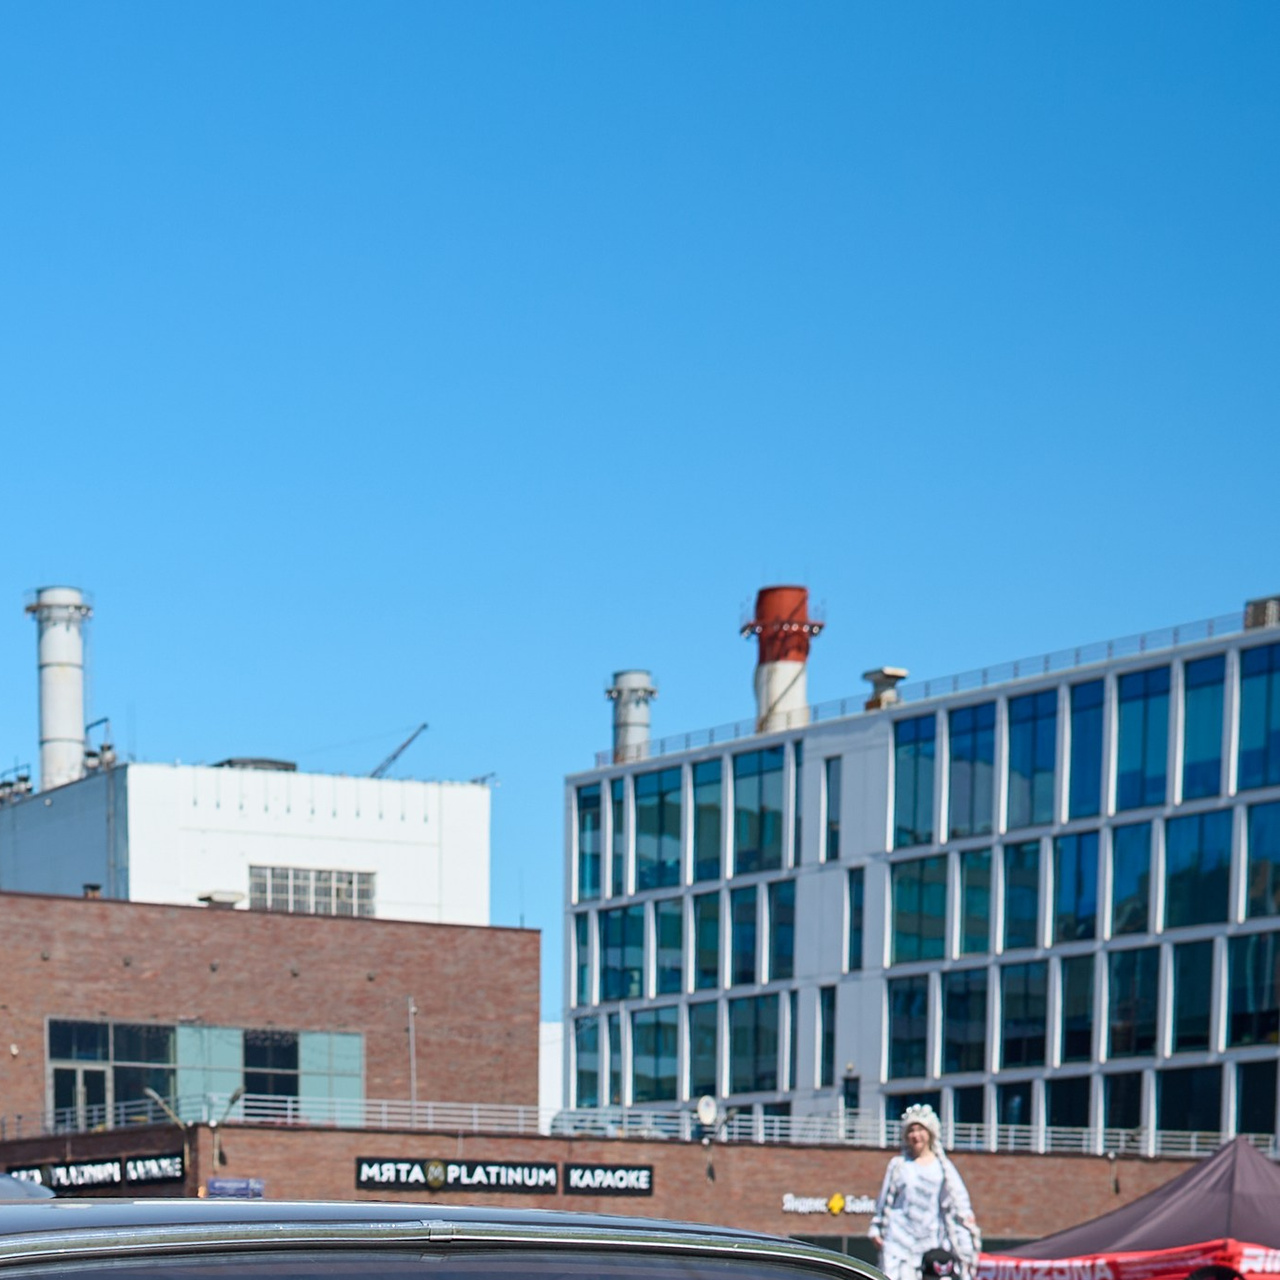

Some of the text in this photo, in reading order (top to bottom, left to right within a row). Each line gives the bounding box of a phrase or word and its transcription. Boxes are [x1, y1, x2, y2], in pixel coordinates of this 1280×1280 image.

[360, 1162, 426, 1183] МЯТА
[447, 1163, 557, 1187] PLATINUM
[569, 1168, 651, 1190] КАРАОКЕ
